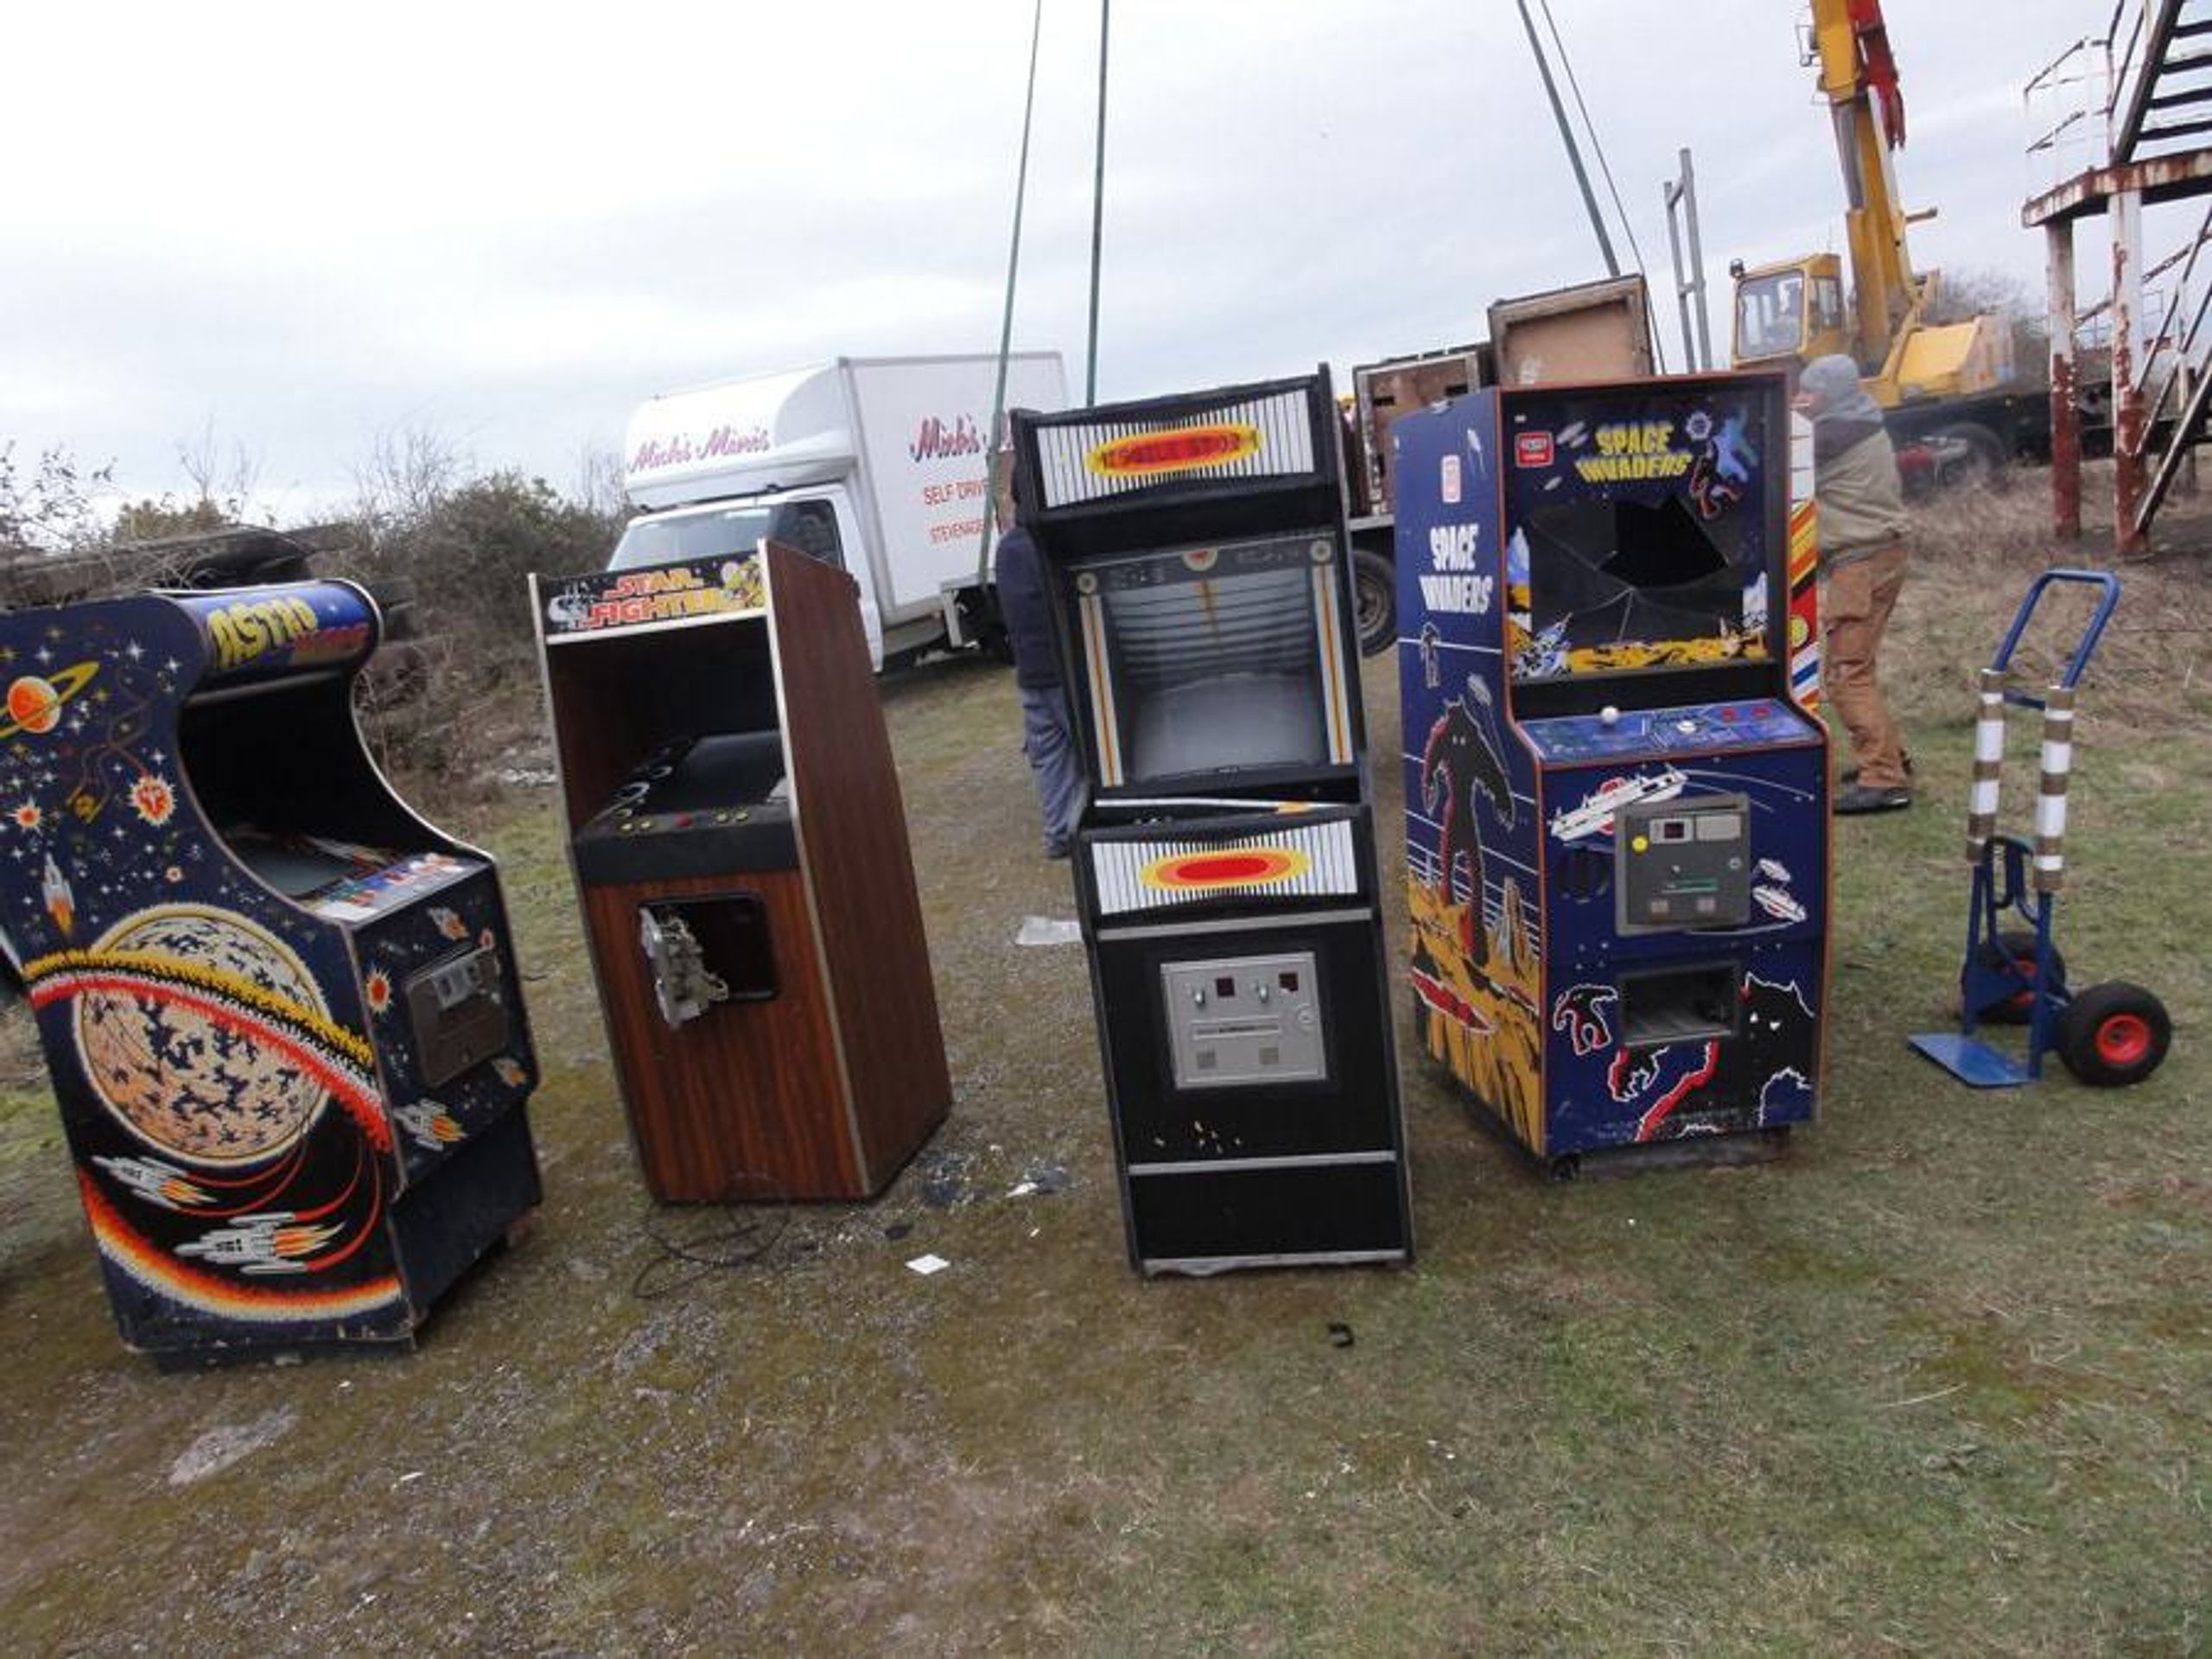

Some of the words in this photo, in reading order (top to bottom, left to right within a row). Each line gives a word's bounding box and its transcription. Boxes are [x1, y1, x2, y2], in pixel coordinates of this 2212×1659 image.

[1595, 423, 1675, 455] SPACE
[1574, 450, 1693, 482] INVADERS
[924, 484, 953, 506] SELF
[956, 479, 991, 499] DRIV
[1430, 523, 1479, 572] SPACE
[602, 567, 704, 601] STAR
[1418, 575, 1494, 614] INVADERS
[207, 597, 317, 669] ASTRO
